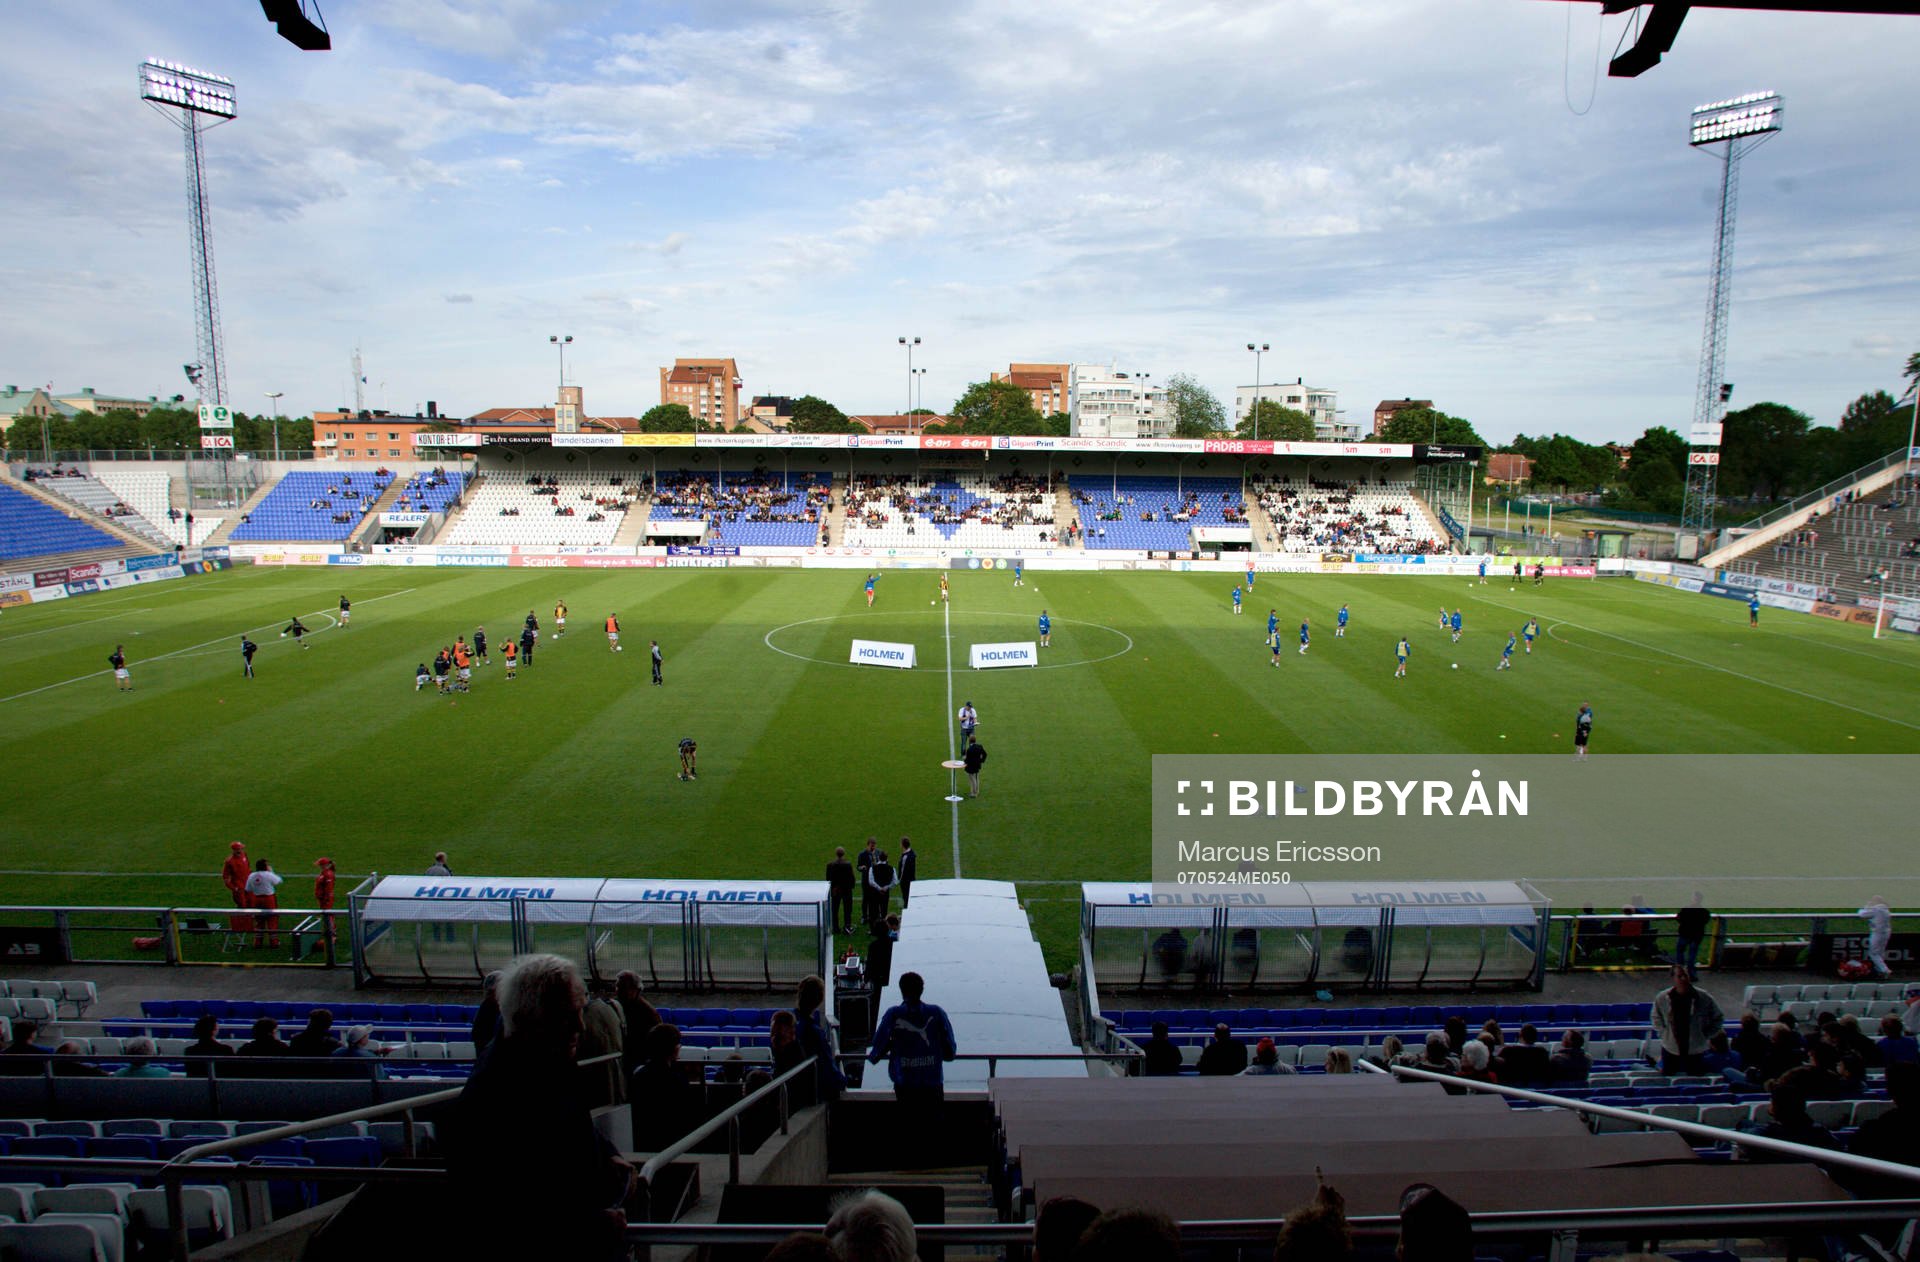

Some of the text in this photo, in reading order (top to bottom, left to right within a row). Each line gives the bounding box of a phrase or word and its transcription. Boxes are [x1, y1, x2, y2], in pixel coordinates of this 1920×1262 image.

[214, 437, 232, 447] ICA
[554, 436, 614, 444] Handelsbanken
[860, 438, 903, 446] GigantPrint
[1011, 439, 1054, 448] GigantPrint
[1205, 441, 1244, 453] PADAB
[1690, 454, 1707, 463] ICA
[390, 514, 428, 522] REJLERS
[437, 555, 509, 567] LOKALDELEN
[522, 556, 568, 567] Scandic
[667, 557, 727, 567] STRYKTIPSET
[71, 566, 101, 580] Scandic
[859, 648, 905, 661] HOLMEN
[981, 650, 1029, 661] HOLMEN
[414, 886, 554, 900] HOLMEN
[642, 889, 782, 902] HOLMEN
[1128, 892, 1266, 904] HOLMEN
[1351, 891, 1487, 903] HOLMEN
